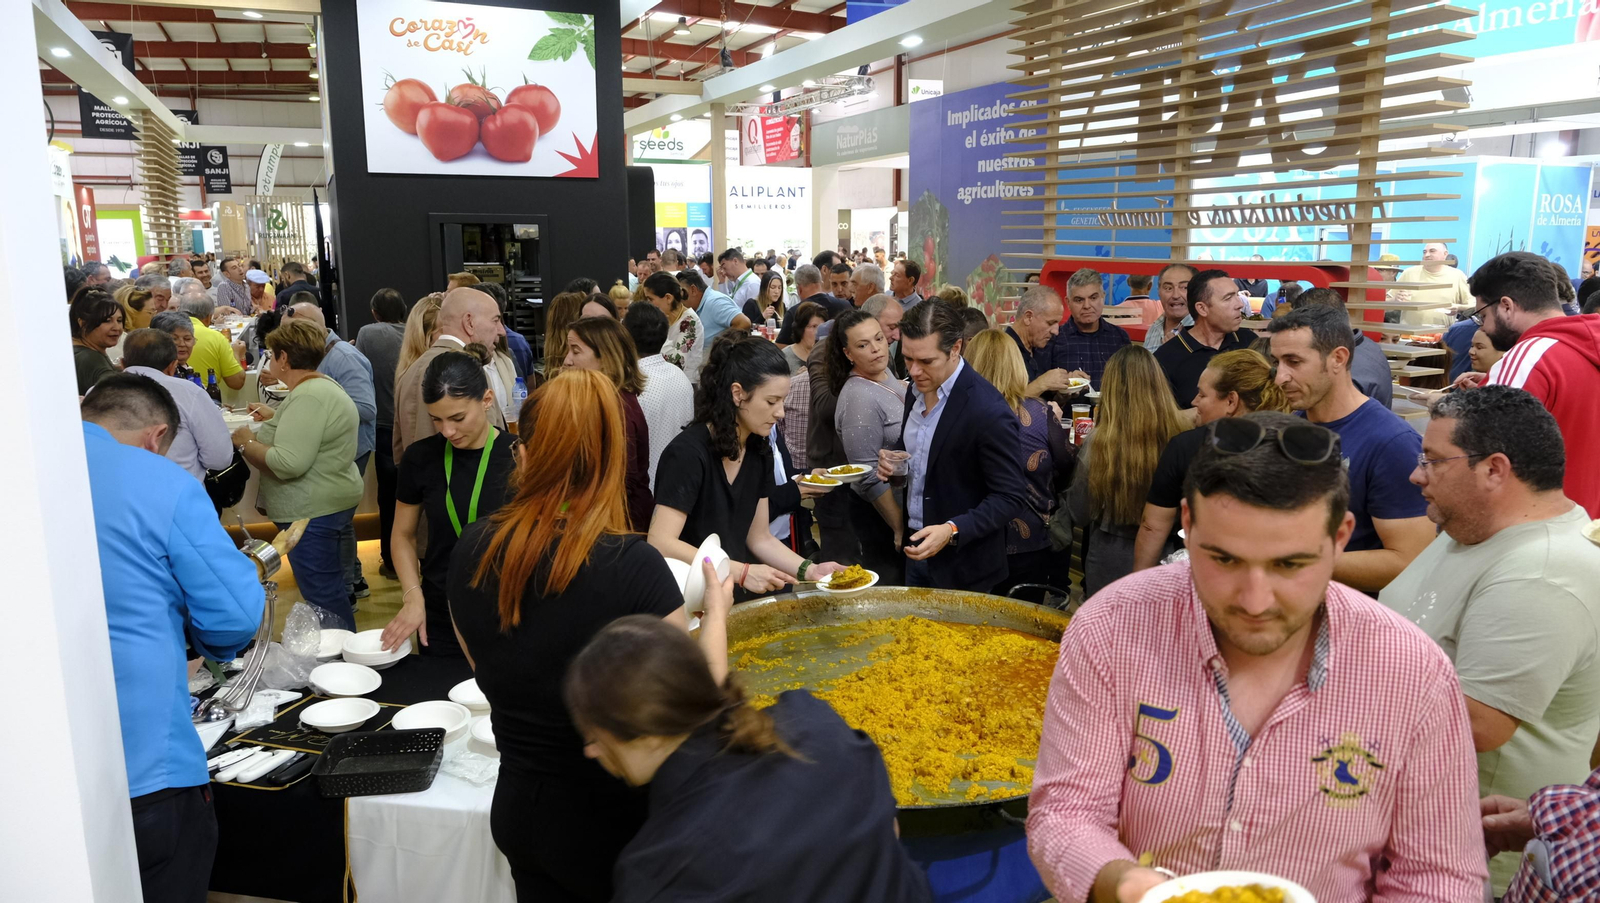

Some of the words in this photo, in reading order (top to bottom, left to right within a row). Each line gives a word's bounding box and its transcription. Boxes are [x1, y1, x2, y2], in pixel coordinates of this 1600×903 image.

[407, 39, 421, 48] de
[423, 33, 474, 56] Casi
[921, 89, 941, 97] Unicaja
[947, 100, 1016, 129] Implicados
[965, 130, 976, 149] el
[980, 127, 1015, 147] éxito
[978, 157, 1035, 173] nuestros
[729, 185, 806, 198] ALIPLANT
[957, 180, 1034, 205] agricultores
[1539, 193, 1583, 214] ROSA
[1537, 214, 1547, 226] de
[1549, 214, 1582, 226] Almería
[1128, 702, 1180, 787] 5
